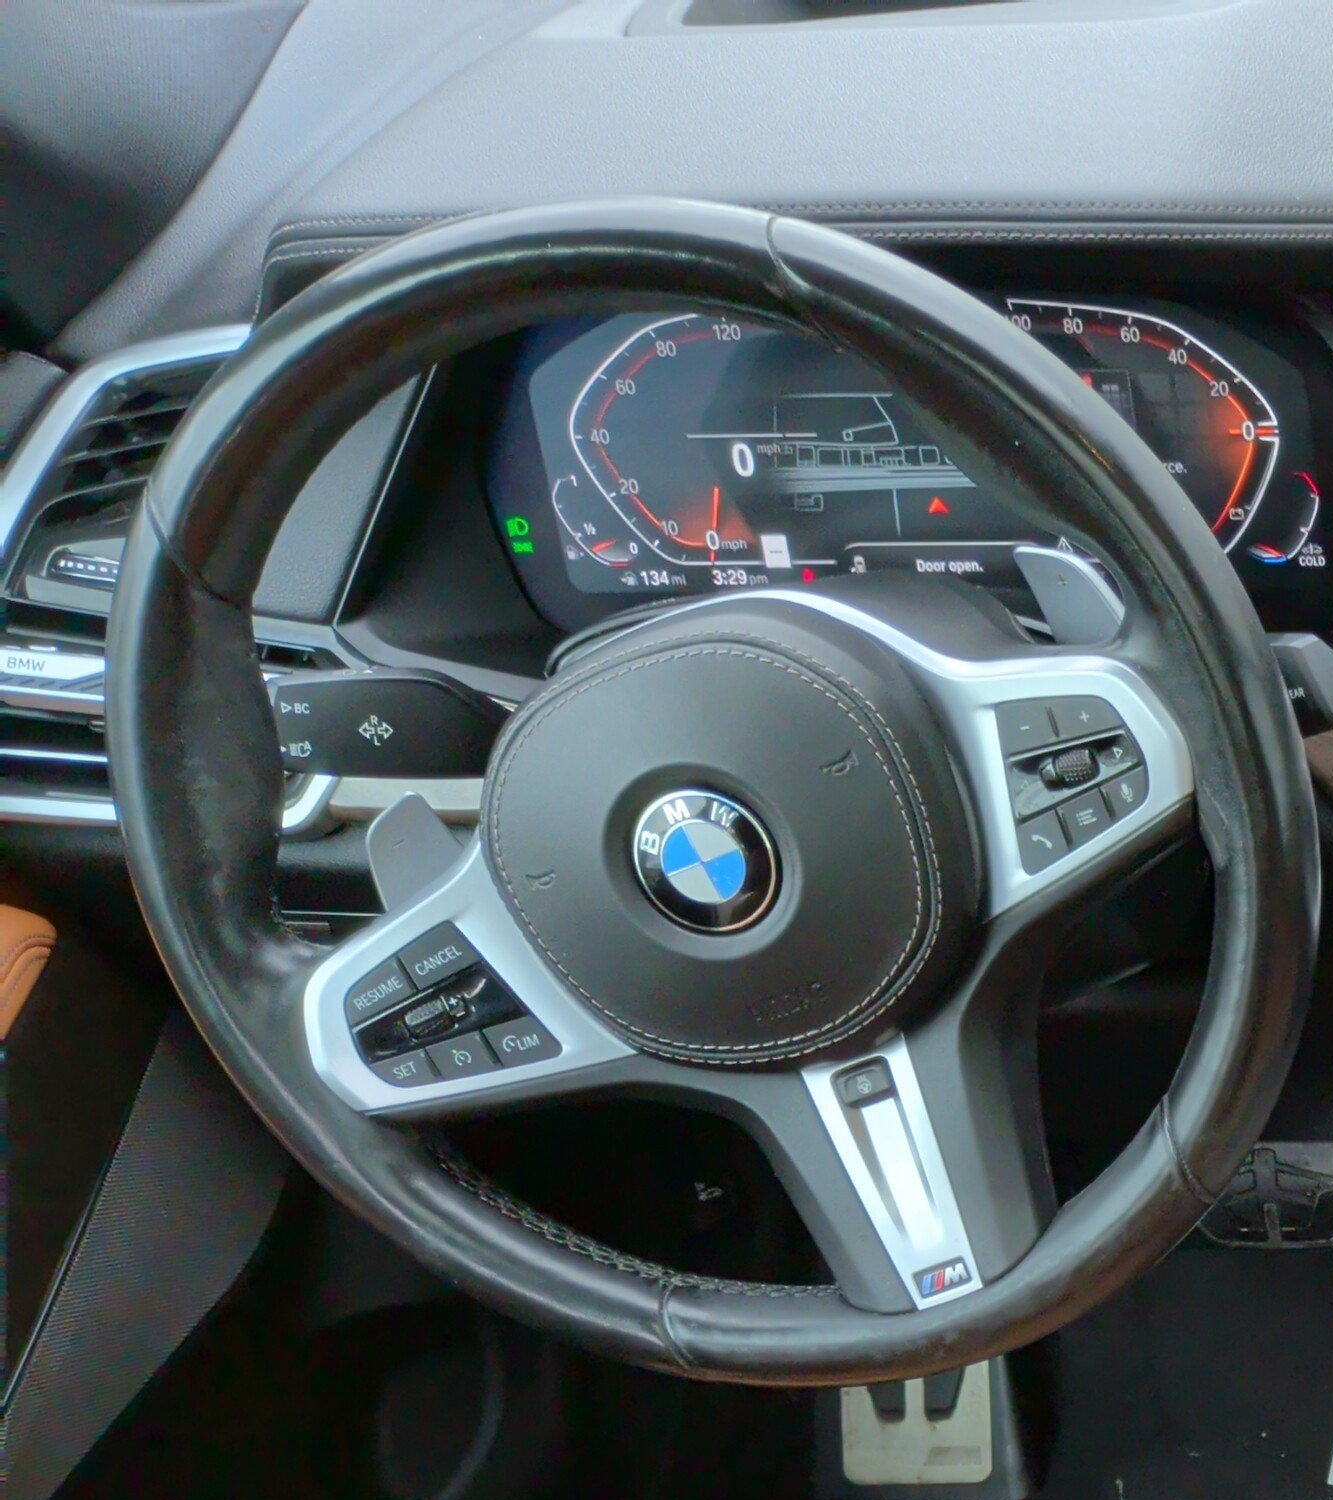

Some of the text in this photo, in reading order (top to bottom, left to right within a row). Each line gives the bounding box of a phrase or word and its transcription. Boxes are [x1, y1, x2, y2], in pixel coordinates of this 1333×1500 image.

[712, 323, 742, 342] 120
[1064, 318, 1083, 335] 80
[1120, 326, 1140, 344] 60
[656, 340, 677, 358] 80
[1168, 348, 1188, 366] 40
[615, 378, 636, 396] 60
[1211, 380, 1230, 398] 20
[590, 428, 610, 445] 40
[1242, 420, 1254, 441] 0
[731, 441, 782, 478] 0 mph
[620, 478, 639, 495] 20
[662, 519, 679, 537] 10
[629, 541, 639, 555] 0
[706, 529, 747, 552] 0 mph
[915, 558, 985, 576] Door open.
[1299, 555, 1326, 568] COLD
[640, 570, 687, 587] 134 mi
[711, 569, 769, 589] 3:29 pm
[6, 656, 46, 672] BMW
[293, 702, 310, 714] BC
[369, 714, 379, 726] R
[373, 735, 382, 746] L
[640, 798, 740, 856] BMW
[414, 944, 463, 977] CANCEL
[352, 975, 404, 1011] RESUME
[516, 1033, 541, 1051] LIM
[392, 1062, 417, 1080] SET
